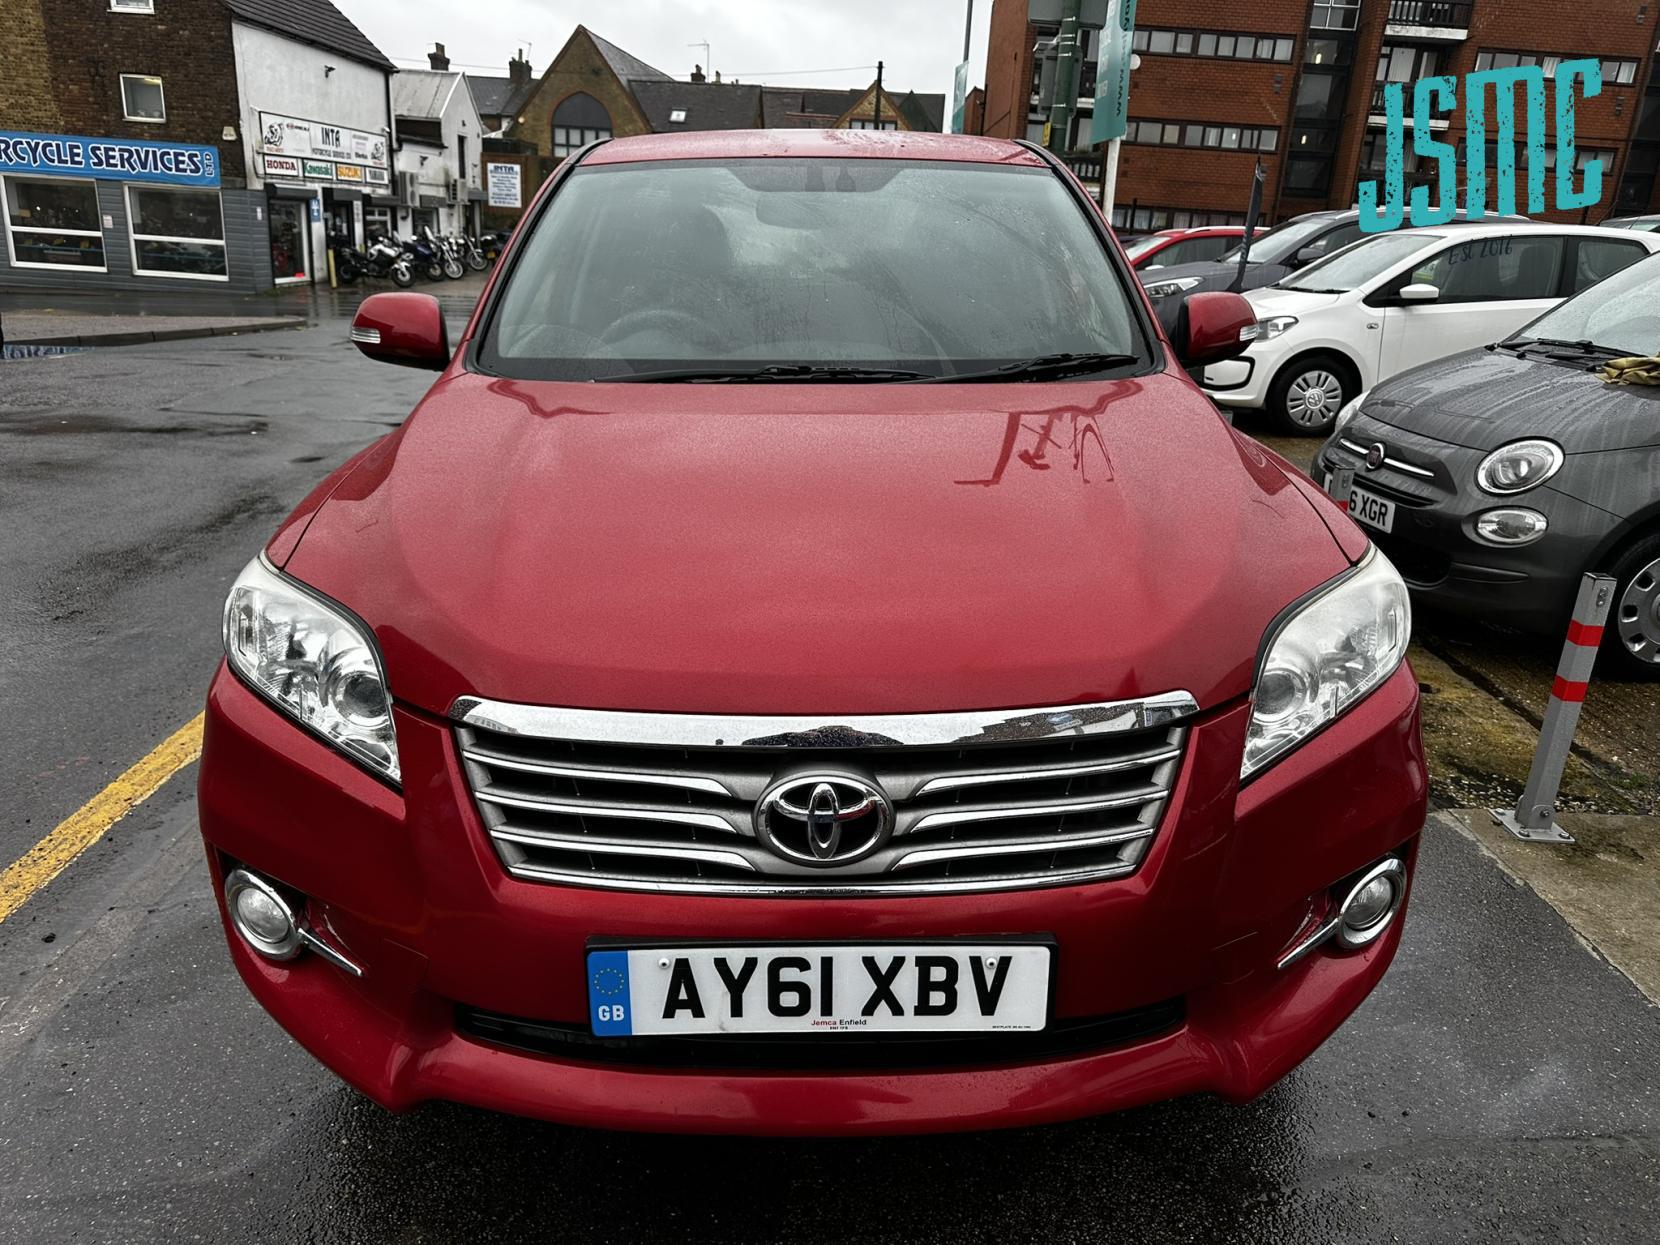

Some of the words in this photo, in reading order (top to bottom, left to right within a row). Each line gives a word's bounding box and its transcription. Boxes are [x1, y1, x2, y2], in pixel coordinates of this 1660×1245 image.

[321, 127, 341, 148] INTA
[0, 137, 84, 167] RCYCLE
[89, 143, 203, 176] SERVICES
[204, 152, 215, 177] LTD
[266, 160, 296, 171] HONDA
[1359, 493, 1388, 526] XGR
[661, 956, 833, 1019] AY61
[861, 955, 1013, 1017] XBV
[598, 1005, 625, 1021] GB
